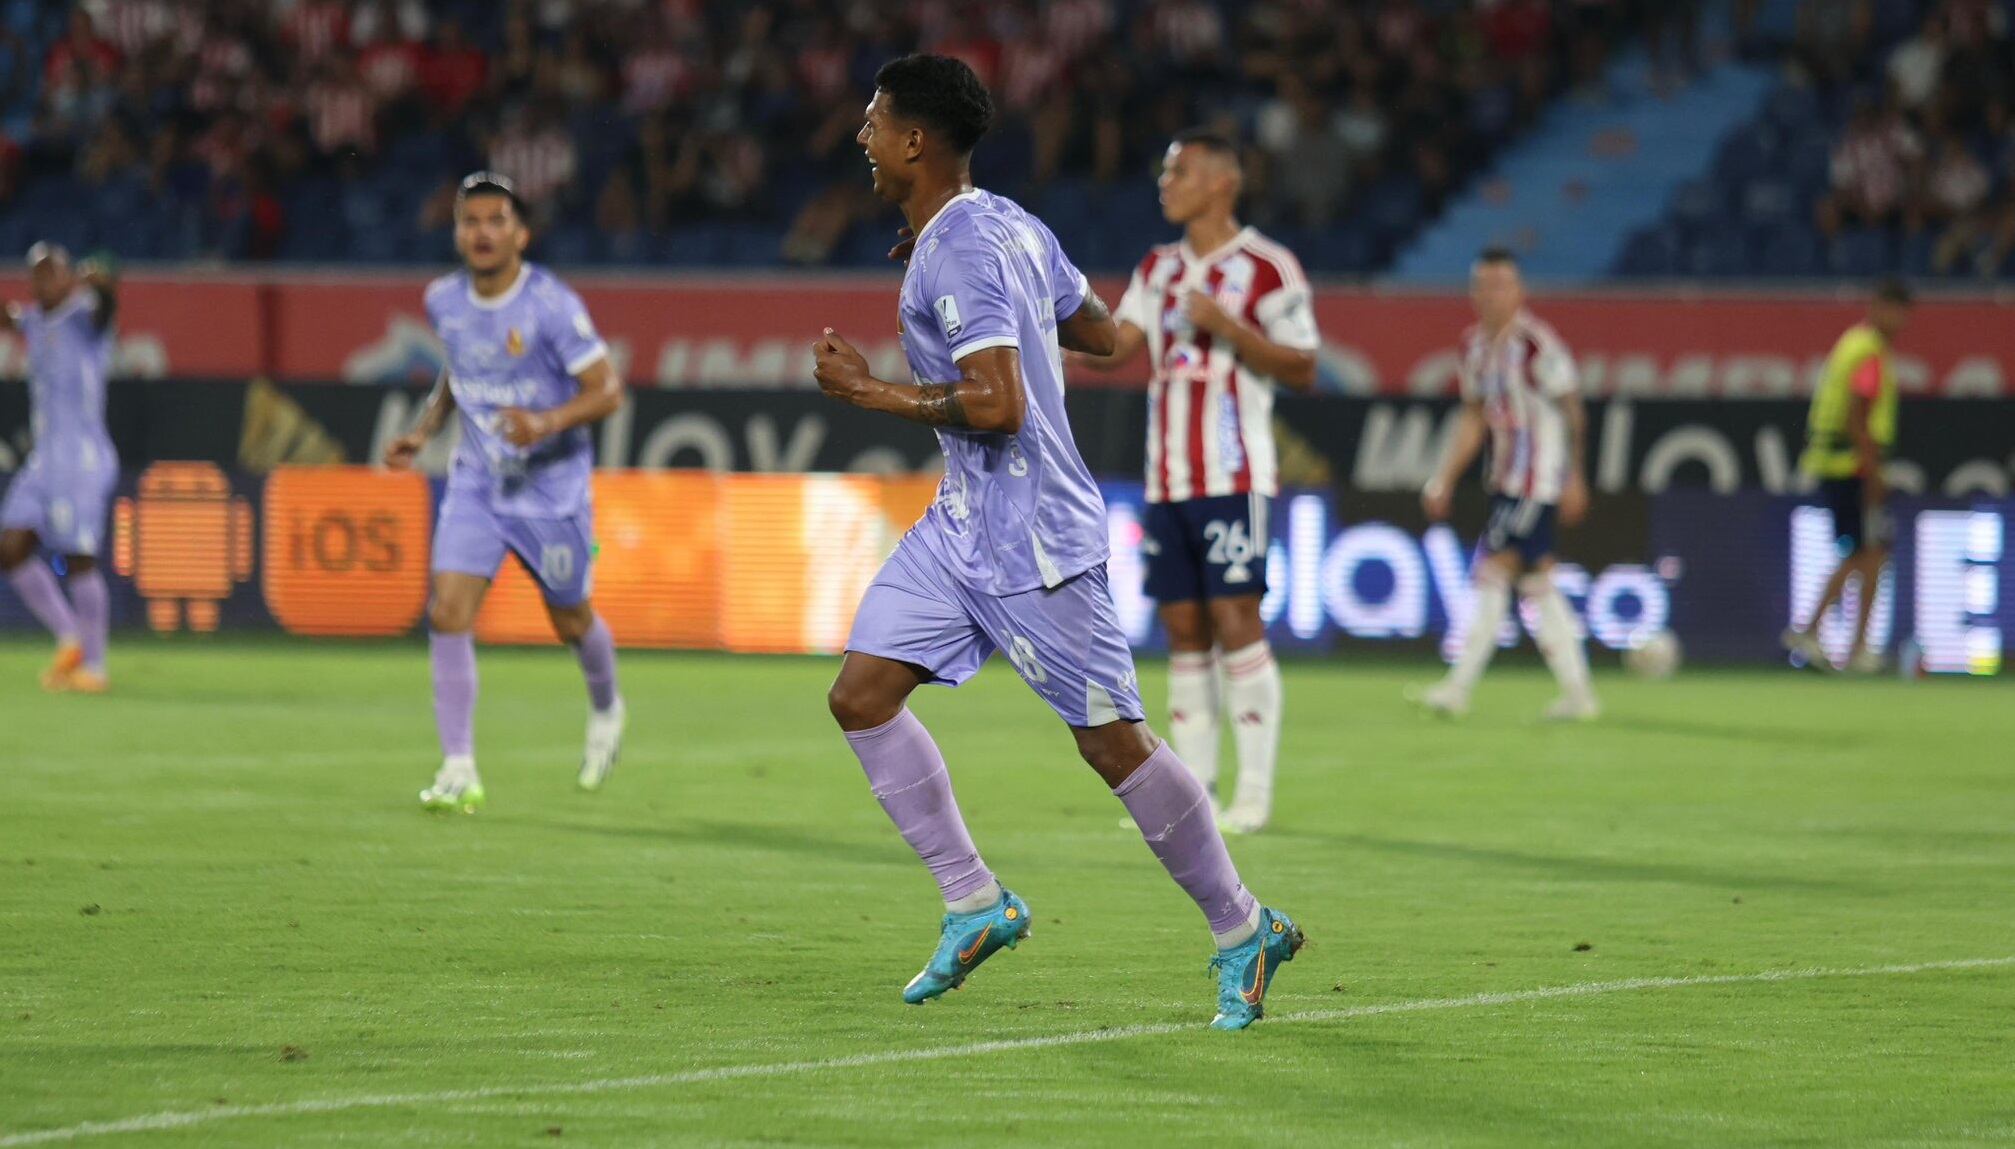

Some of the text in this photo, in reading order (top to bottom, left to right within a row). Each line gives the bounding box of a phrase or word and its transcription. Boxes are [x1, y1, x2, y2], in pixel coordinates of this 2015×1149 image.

[287, 507, 404, 573] iOS
[541, 543, 574, 583] 10
[1203, 518, 1254, 565] 26
